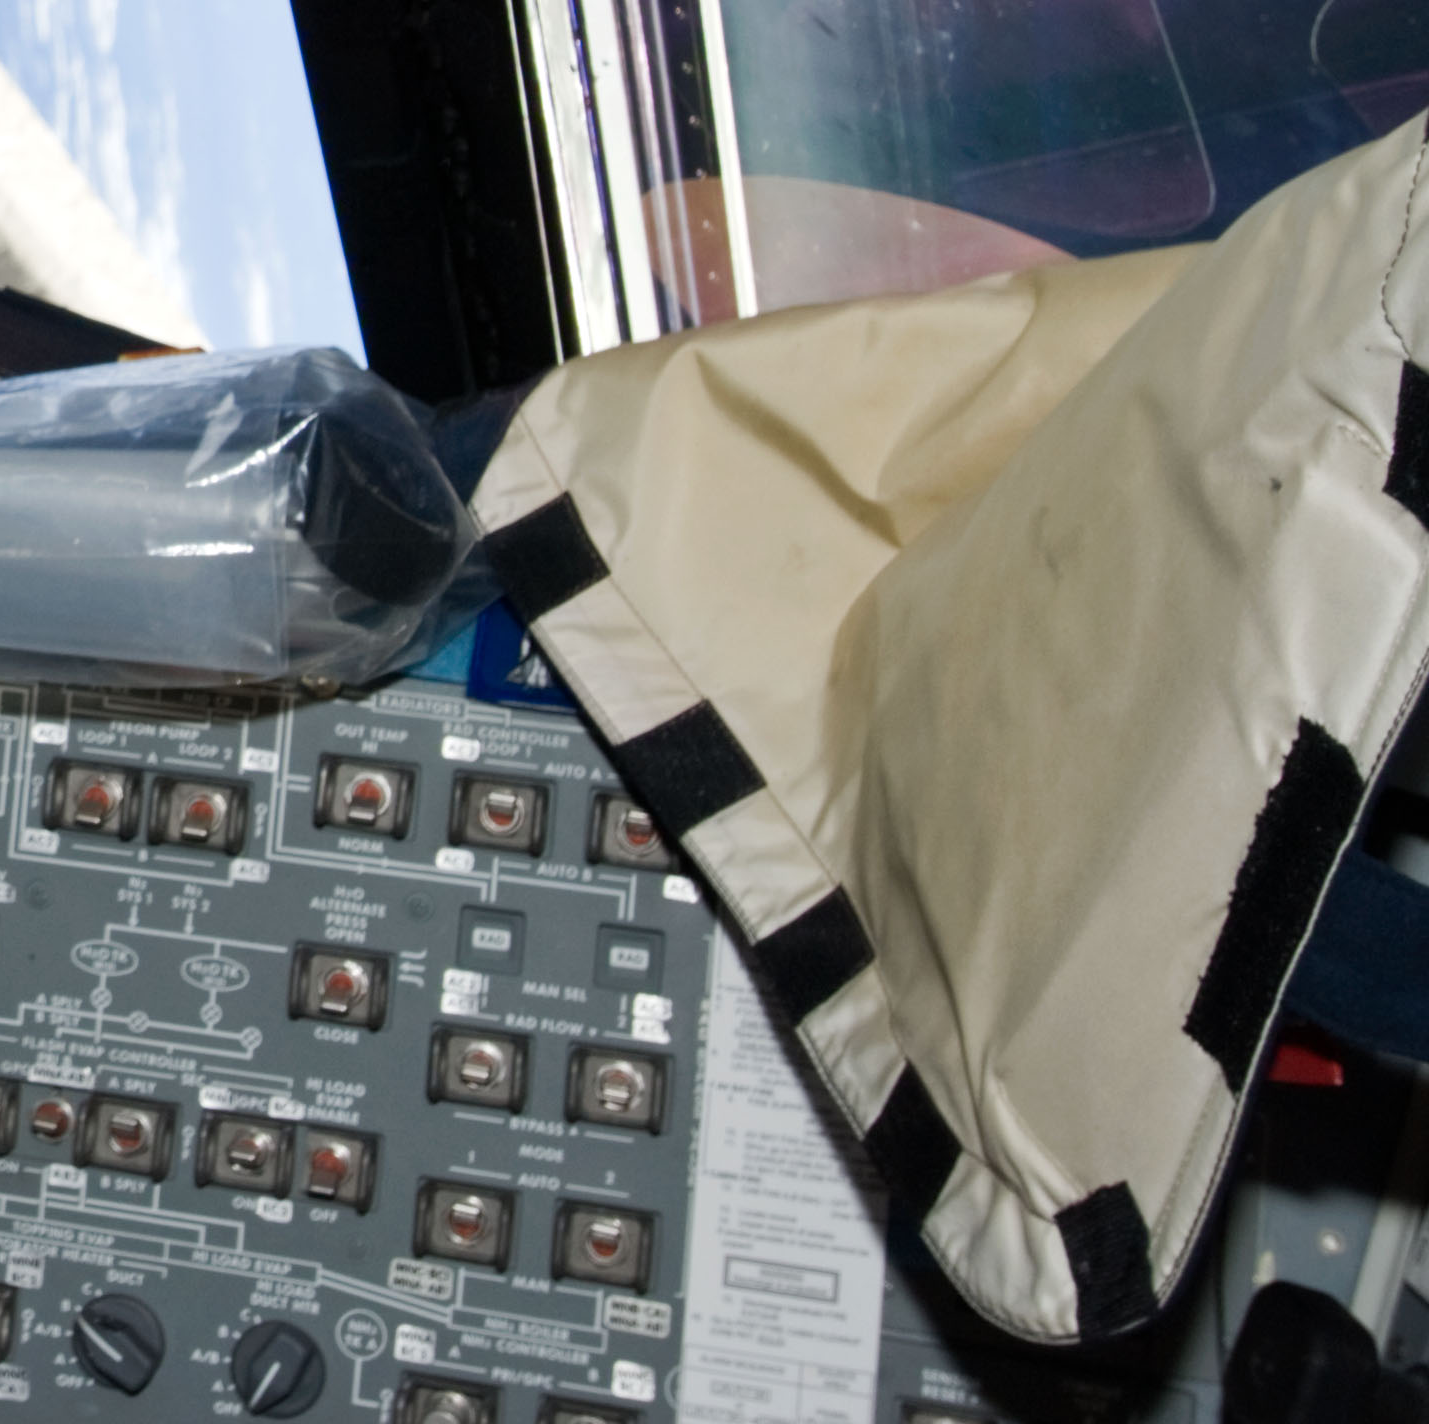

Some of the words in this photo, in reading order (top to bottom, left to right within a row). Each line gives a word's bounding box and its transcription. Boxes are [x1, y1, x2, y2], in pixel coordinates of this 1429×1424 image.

[160, 726, 199, 740] PUMP
[334, 724, 364, 738] OUT
[369, 728, 408, 742] TEMP
[477, 726, 570, 748] CONTROLLER
[362, 741, 377, 753] HI
[147, 752, 157, 764] A
[544, 762, 586, 778] AUTO
[591, 767, 602, 781] A
[339, 838, 385, 854] NORM
[536, 862, 579, 877] AUTO
[581, 868, 592, 882] B
[310, 898, 387, 918] ALTERNATE
[324, 914, 368, 929] PRESS
[324, 928, 367, 943] OPEN
[522, 981, 559, 998] MAN
[564, 985, 587, 1002] SEL
[505, 1014, 537, 1029] RAD
[541, 1017, 584, 1035] FLOW
[314, 1026, 359, 1045] CLOSE
[21, 1036, 65, 1052] FLASH
[109, 1049, 197, 1072] CONTROLLER
[109, 1078, 119, 1088] A
[123, 1080, 157, 1094] SPLY
[305, 1078, 323, 1091] HI
[325, 1080, 365, 1097] LOAD
[316, 1095, 354, 1108] EVAP
[306, 1106, 359, 1126] ENABLE
[510, 1117, 564, 1136] BYPASS
[519, 1145, 564, 1161] MODE
[518, 1175, 560, 1191] AUTO
[605, 1171, 615, 1184] 2
[114, 1178, 147, 1194] SPLY
[309, 1209, 338, 1223] OFF
[13, 1221, 70, 1242] TOPPING
[73, 1231, 115, 1246] EVAP
[61, 1250, 114, 1266] HEATER
[192, 1250, 209, 1262] HI
[213, 1252, 252, 1271] LOAD
[254, 1260, 293, 1275] EVAP
[106, 1269, 145, 1286] DUCT
[512, 1276, 552, 1292] MAN
[250, 1293, 288, 1309] DUCT
[33, 1324, 62, 1336] A/B
[519, 1322, 570, 1340] BOILER
[190, 1349, 219, 1363] A/B
[449, 1346, 461, 1358] A
[496, 1338, 590, 1365] CONTROLLER
[53, 1354, 66, 1366] A
[55, 1375, 83, 1388] OFF
[212, 1380, 223, 1392] A
[213, 1401, 242, 1415] OFF
